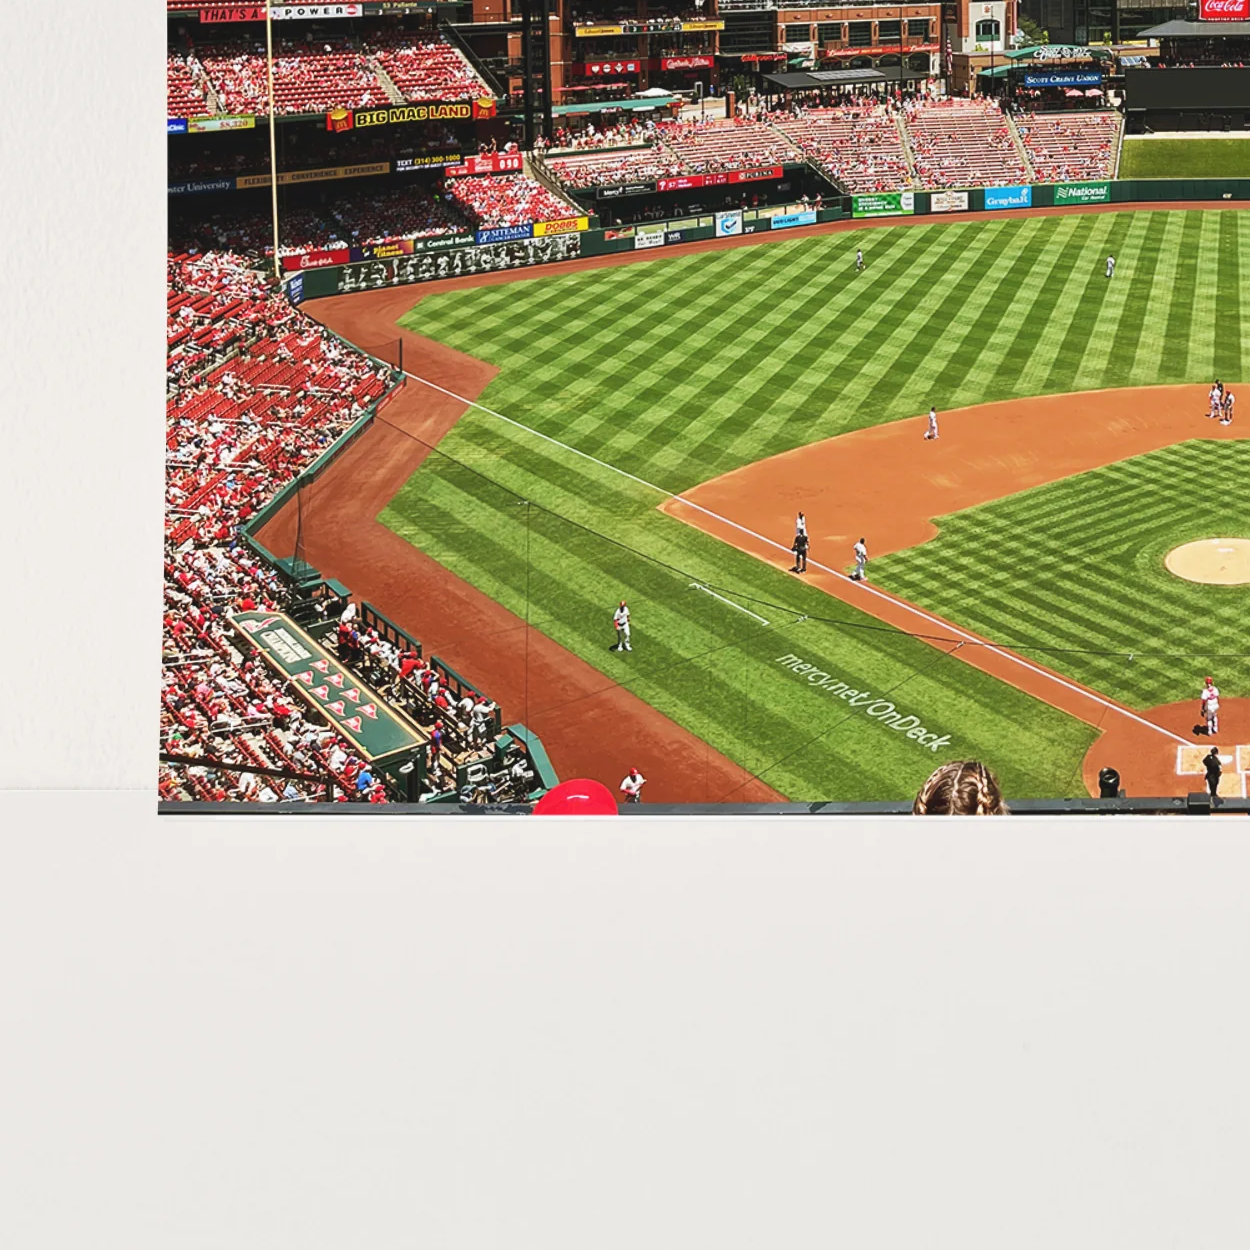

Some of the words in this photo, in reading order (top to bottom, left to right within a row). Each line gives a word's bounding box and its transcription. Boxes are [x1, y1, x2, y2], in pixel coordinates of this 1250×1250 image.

[203, 8, 246, 21] THAT'S
[284, 5, 344, 17] POWER
[355, 112, 388, 127] BIG
[389, 107, 427, 123] MAC
[429, 104, 471, 119] LAND
[746, 169, 774, 179] PURINA
[187, 180, 231, 193] University
[1067, 185, 1107, 196] National
[491, 225, 531, 237] SITEMAN
[545, 219, 578, 231] DOBBS
[427, 236, 454, 248] Central
[455, 234, 474, 245] Bank
[776, 653, 951, 751] mercy.net/OnDeck
